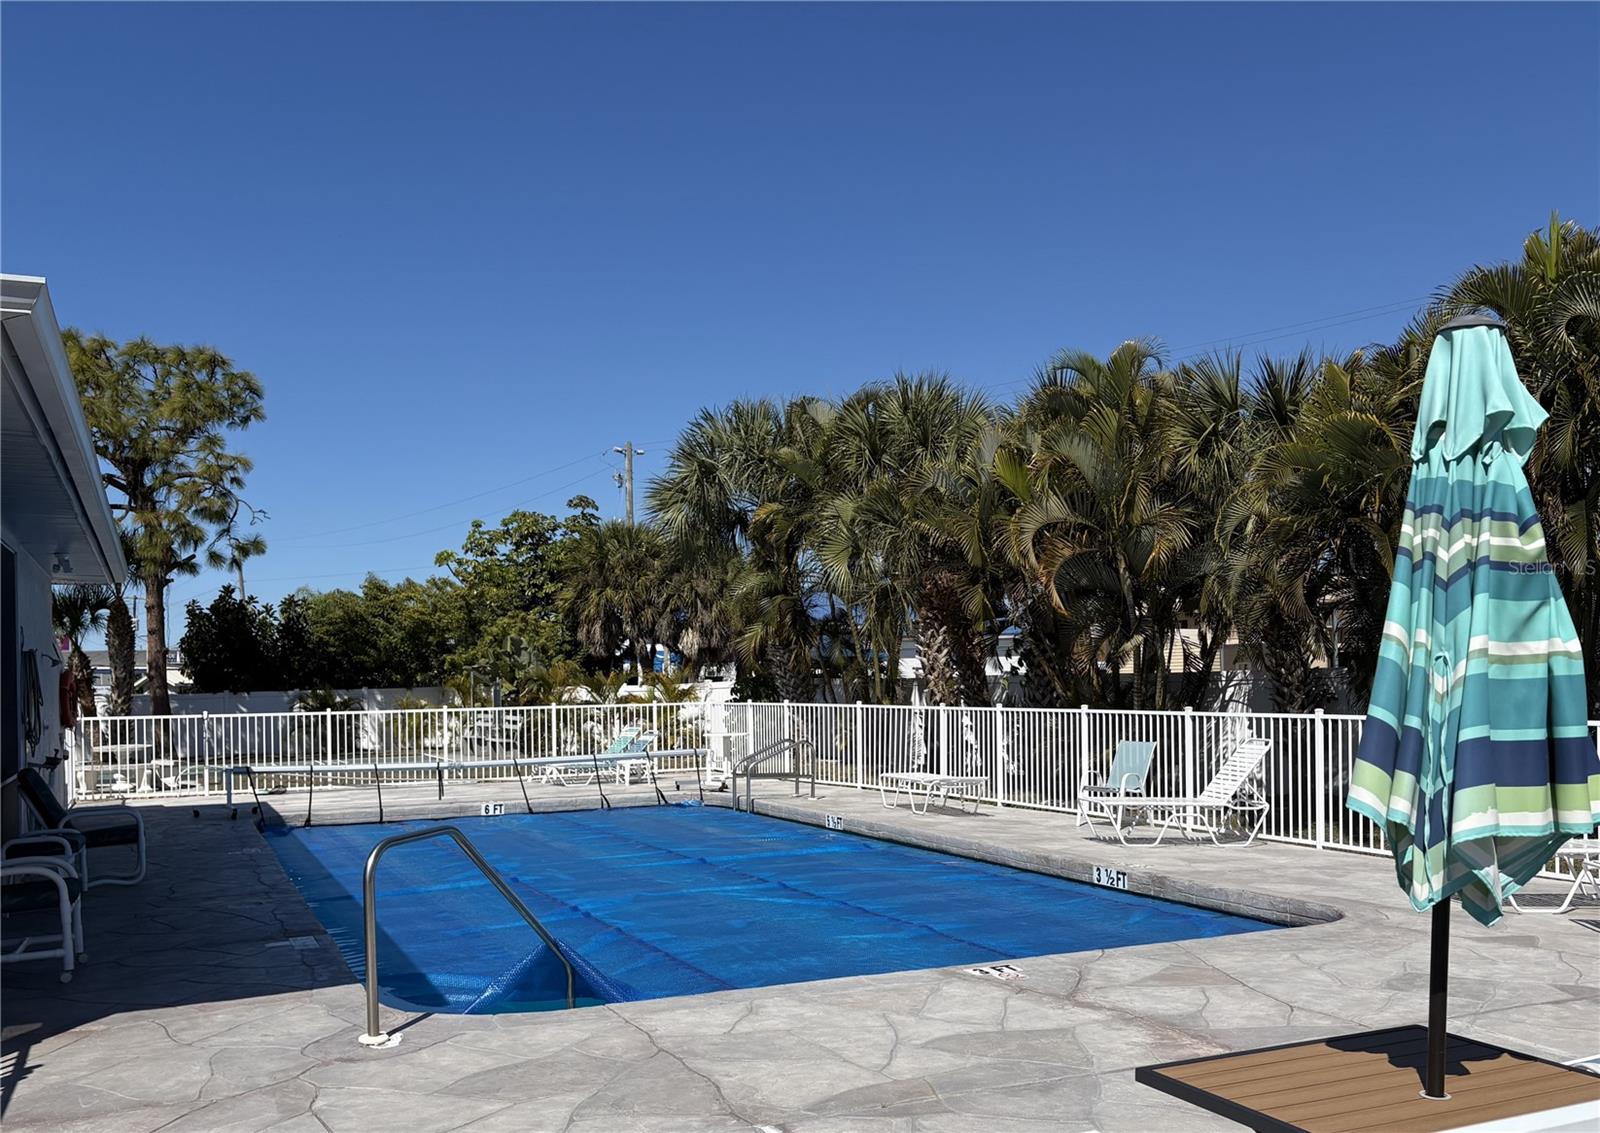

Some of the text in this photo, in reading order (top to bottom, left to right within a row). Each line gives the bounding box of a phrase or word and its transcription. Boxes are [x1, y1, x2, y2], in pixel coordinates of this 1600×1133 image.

[493, 803, 504, 814] FT
[1095, 867, 1101, 883] 3
[989, 964, 1017, 974] FT
